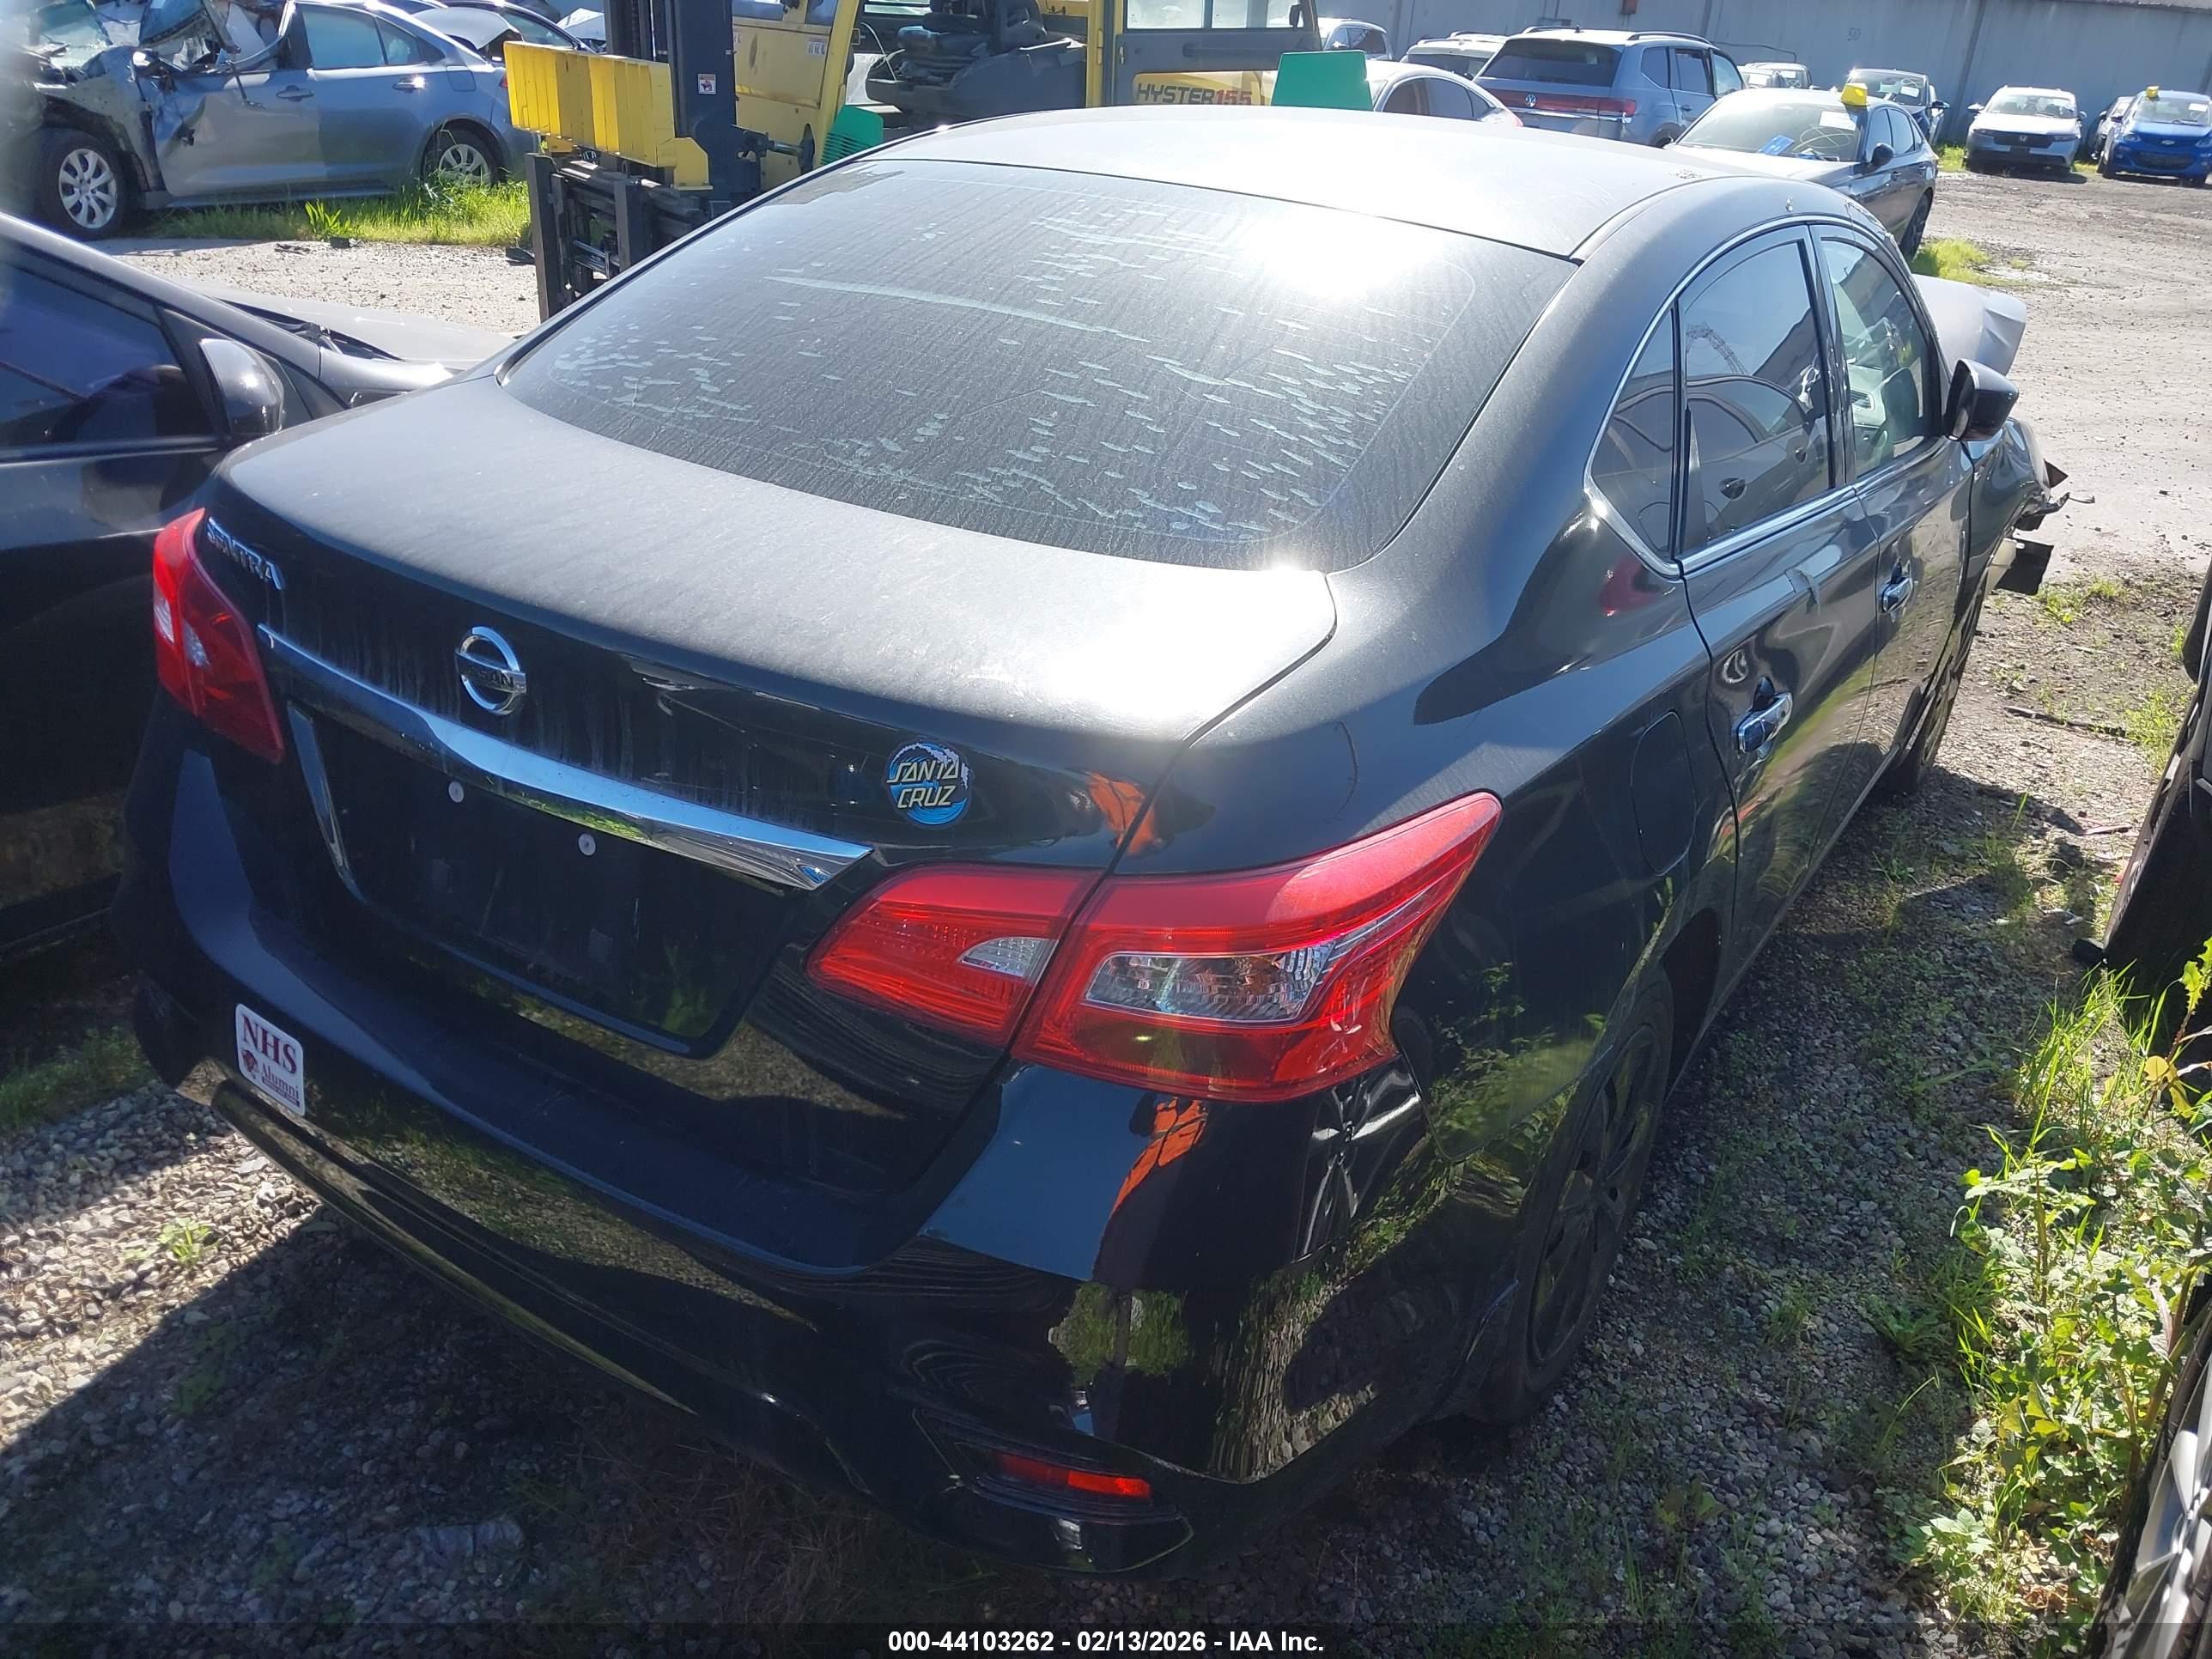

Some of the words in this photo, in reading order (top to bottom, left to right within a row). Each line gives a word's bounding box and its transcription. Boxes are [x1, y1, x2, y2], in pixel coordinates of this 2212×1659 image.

[206, 516, 283, 591] SENTRA
[886, 759, 960, 784] SANTA
[896, 785, 957, 809] CRUZ
[242, 1014, 298, 1075] NHS
[261, 1063, 300, 1100] Alumni
